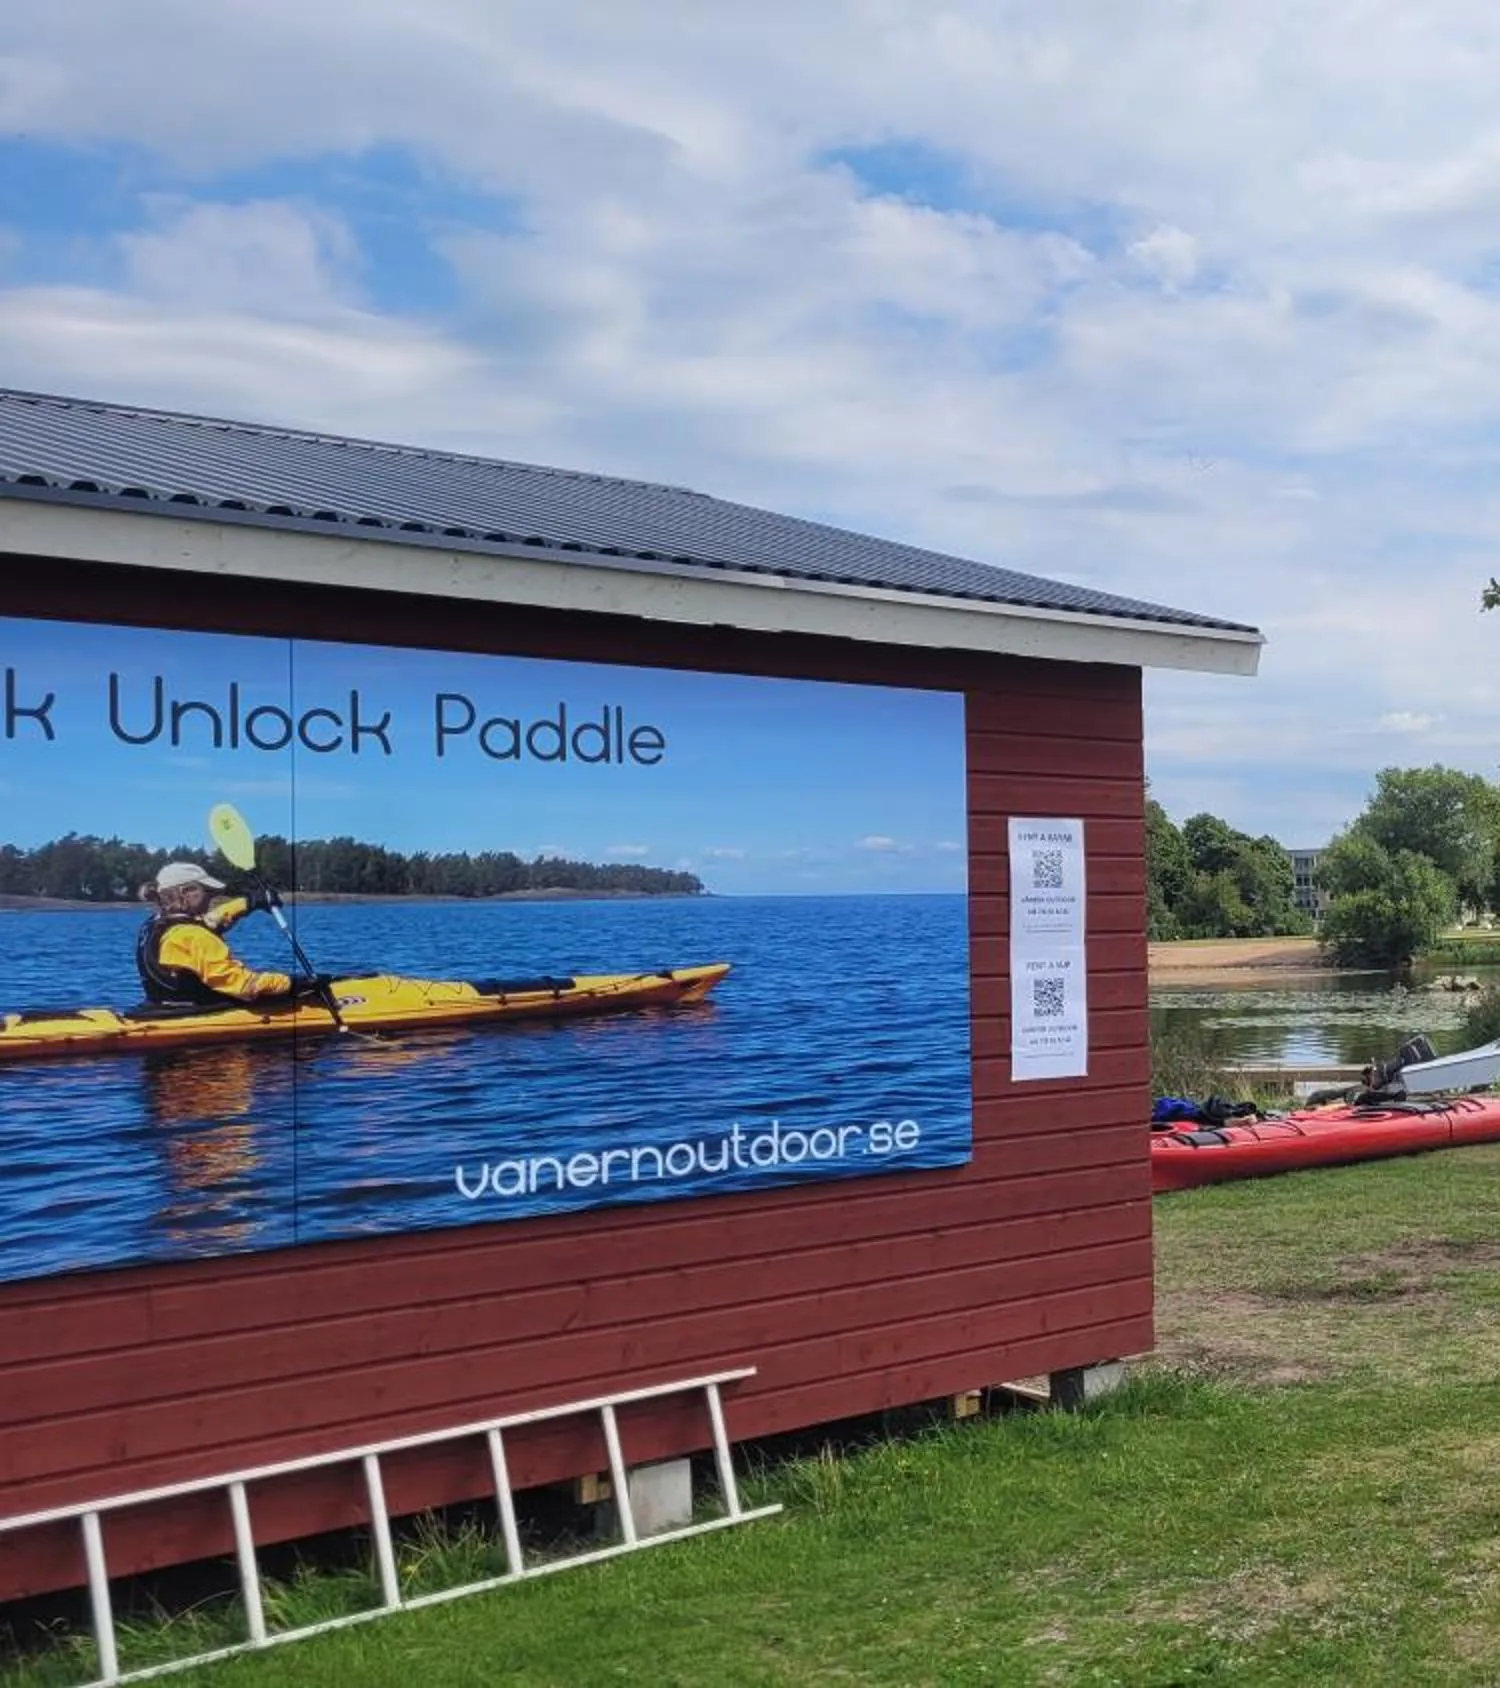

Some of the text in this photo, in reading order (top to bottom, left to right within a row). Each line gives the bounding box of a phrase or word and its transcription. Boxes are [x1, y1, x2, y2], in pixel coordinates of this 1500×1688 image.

[108, 671, 392, 756] Unlock
[435, 692, 666, 765] Paddle
[453, 1118, 922, 1200] vanernoutdoor.se
